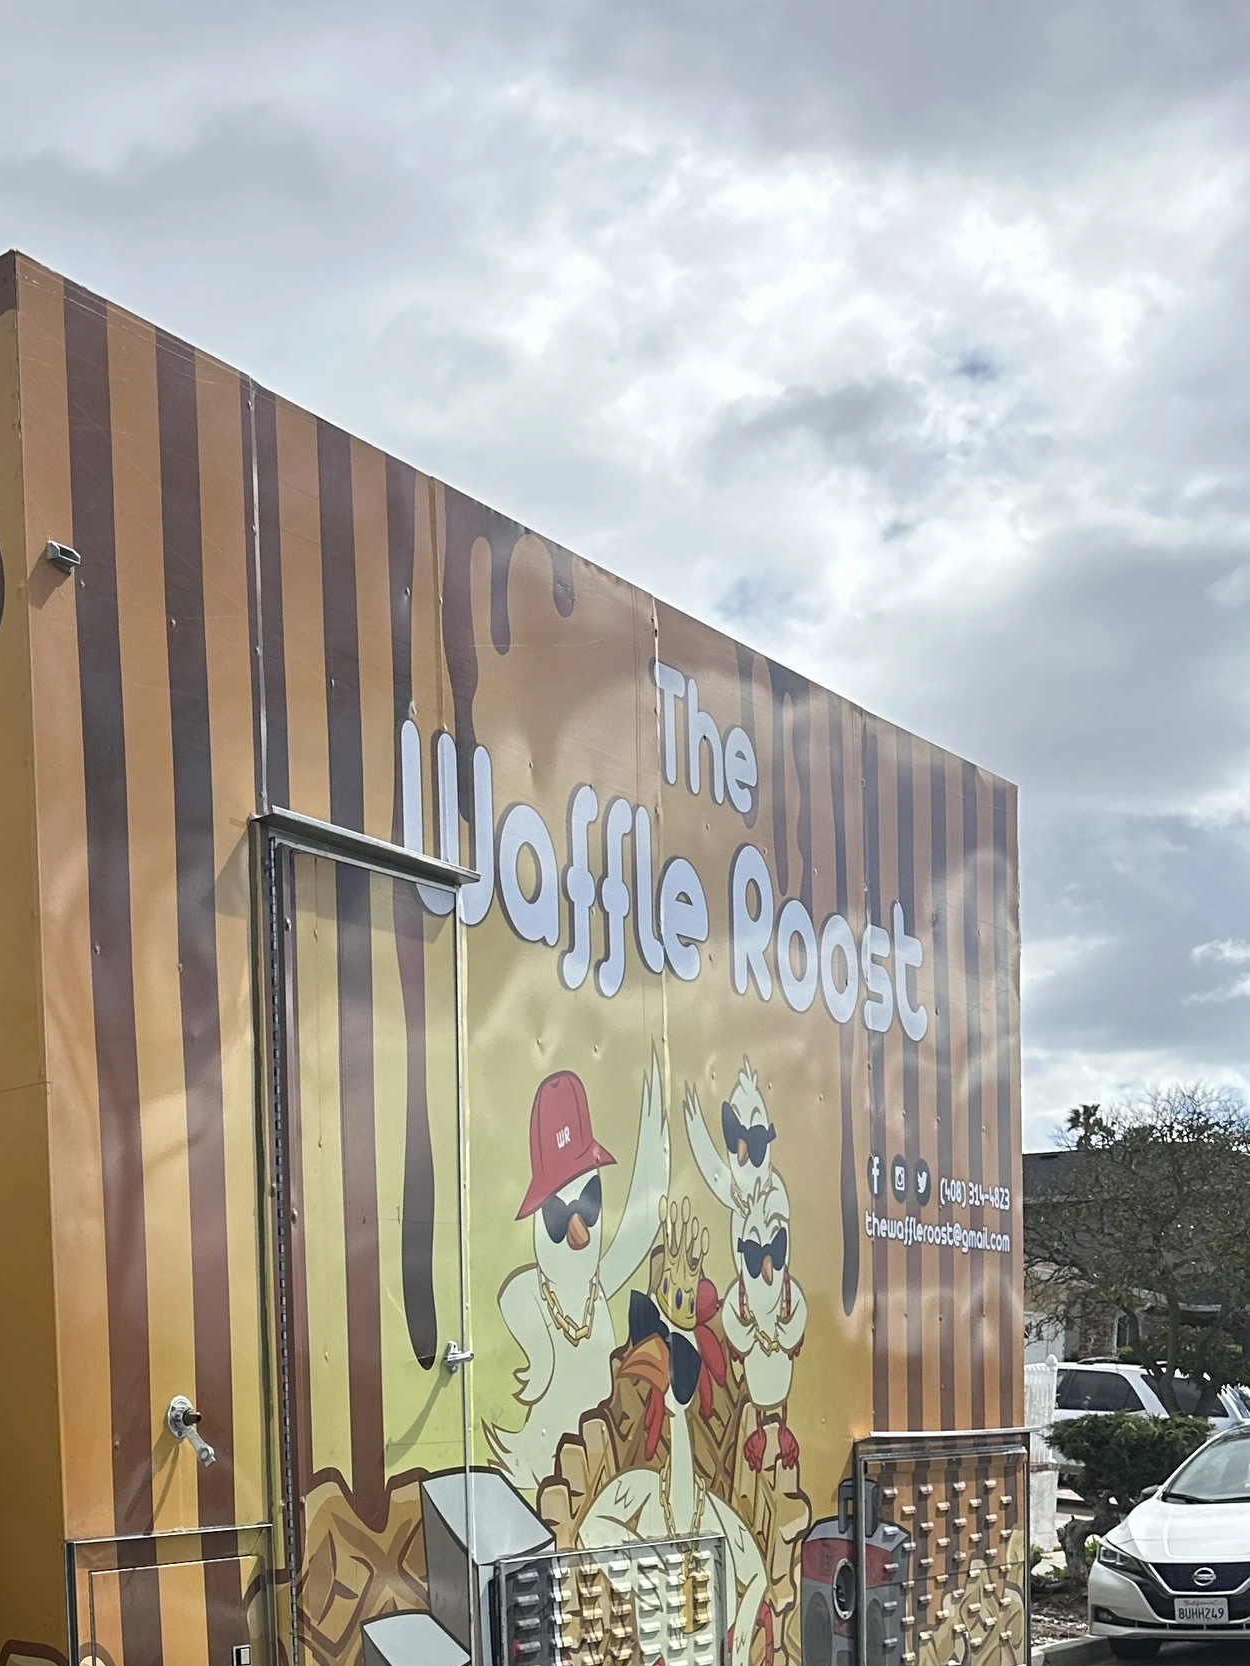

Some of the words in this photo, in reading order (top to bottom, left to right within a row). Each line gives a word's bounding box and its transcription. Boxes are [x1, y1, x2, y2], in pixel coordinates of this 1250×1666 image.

[654, 661, 758, 813] The
[401, 719, 709, 997] Waffle
[730, 844, 928, 1042] Roost
[556, 1126, 571, 1149] WR
[940, 1177, 967, 1209] (408)
[865, 1210, 1011, 1253] thewaffleroost@gmail.com
[1178, 1607, 1225, 1619] 8UHH249
